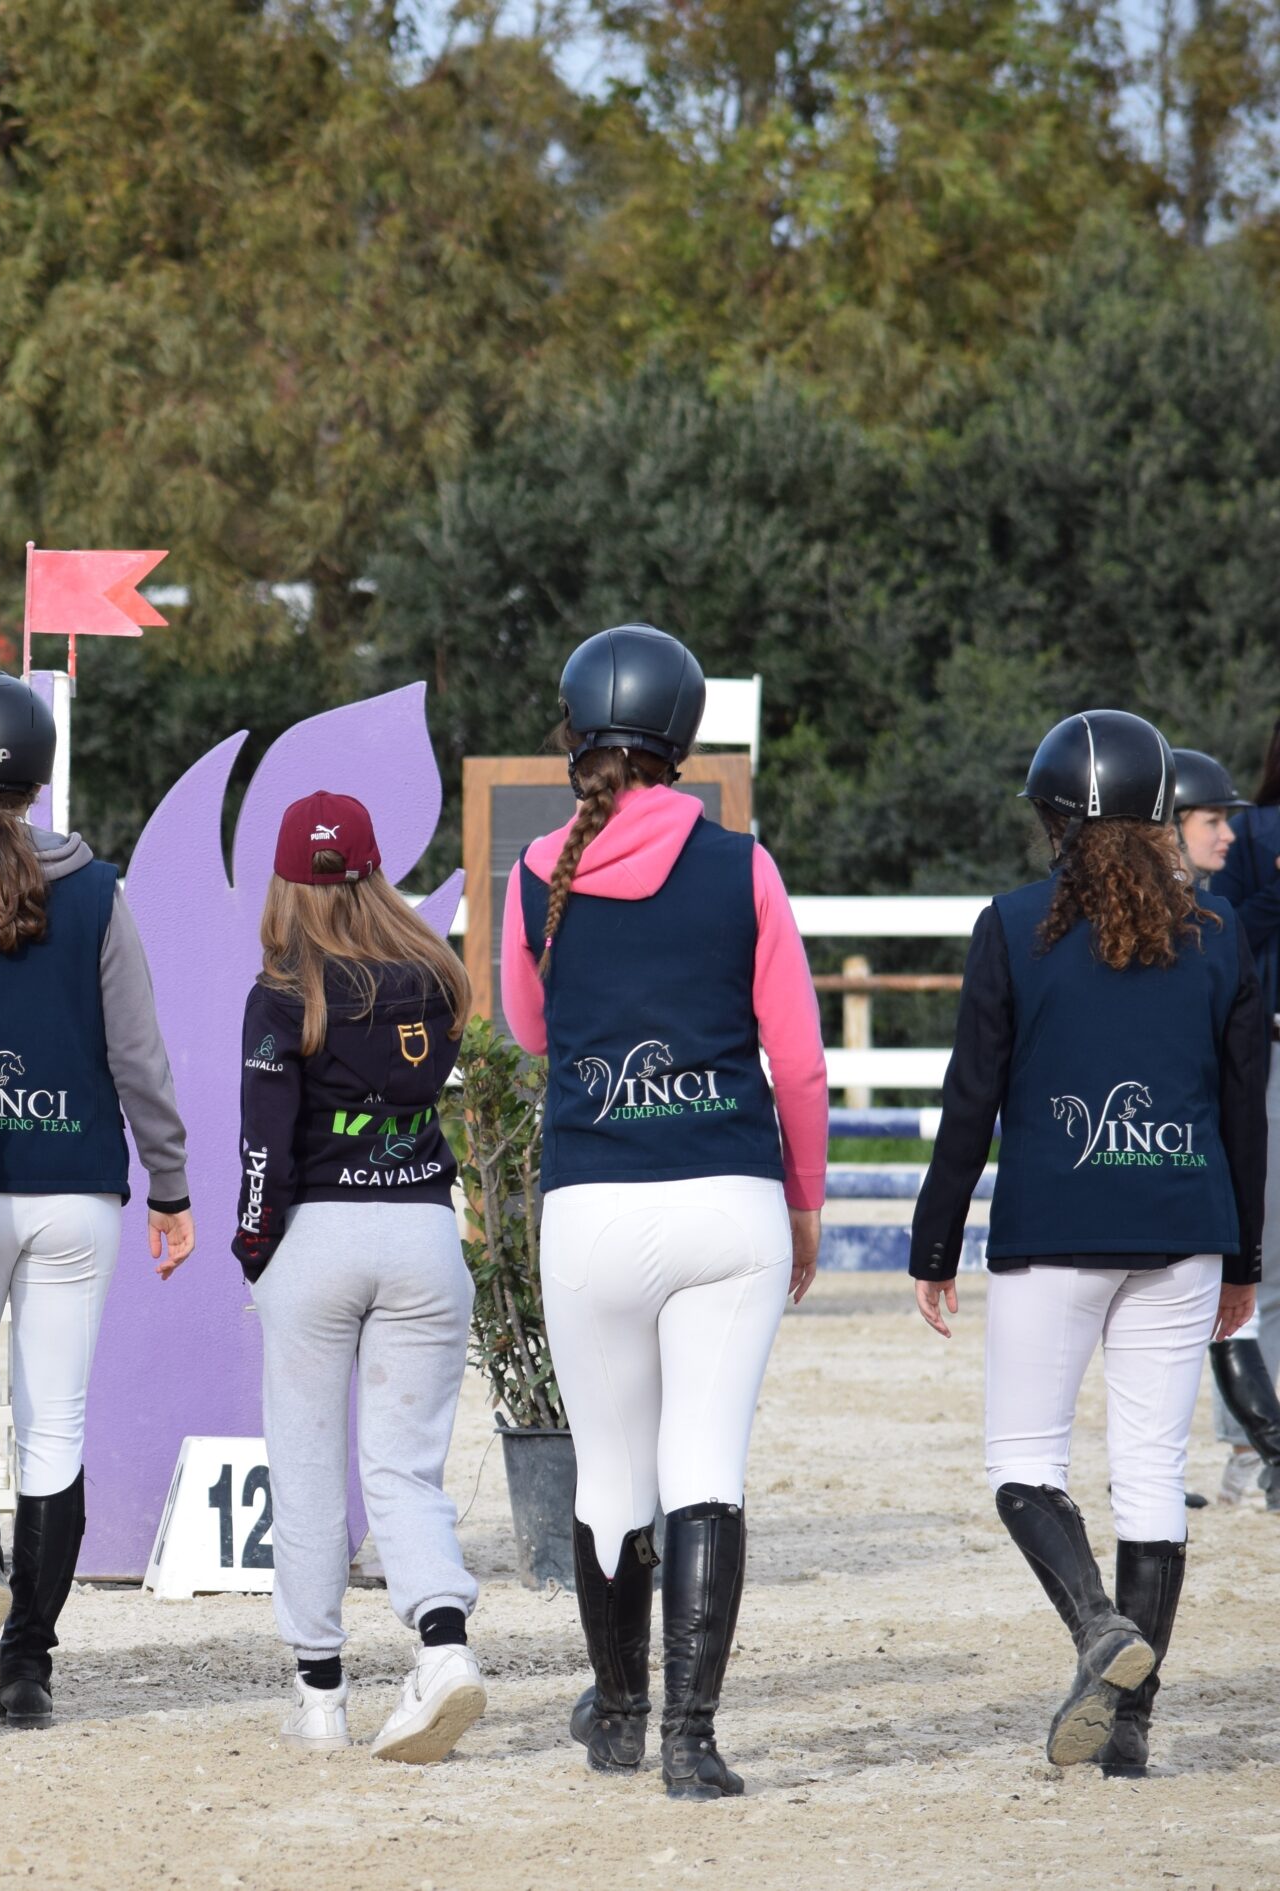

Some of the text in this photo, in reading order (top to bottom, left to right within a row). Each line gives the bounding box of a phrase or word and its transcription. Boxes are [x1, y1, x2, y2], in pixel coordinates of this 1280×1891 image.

[310, 832, 331, 841] PUMA
[245, 1059, 284, 1072] ACAVALLO
[573, 1040, 721, 1125] VINCI
[610, 1098, 738, 1120] JUMPING TEAM
[40, 1119, 82, 1132] TEAM
[1050, 1081, 1193, 1169] VINCI
[1091, 1152, 1208, 1167] JUMPING TEAM
[338, 1162, 441, 1186] ACAVALLO
[209, 1464, 275, 1569] 12
